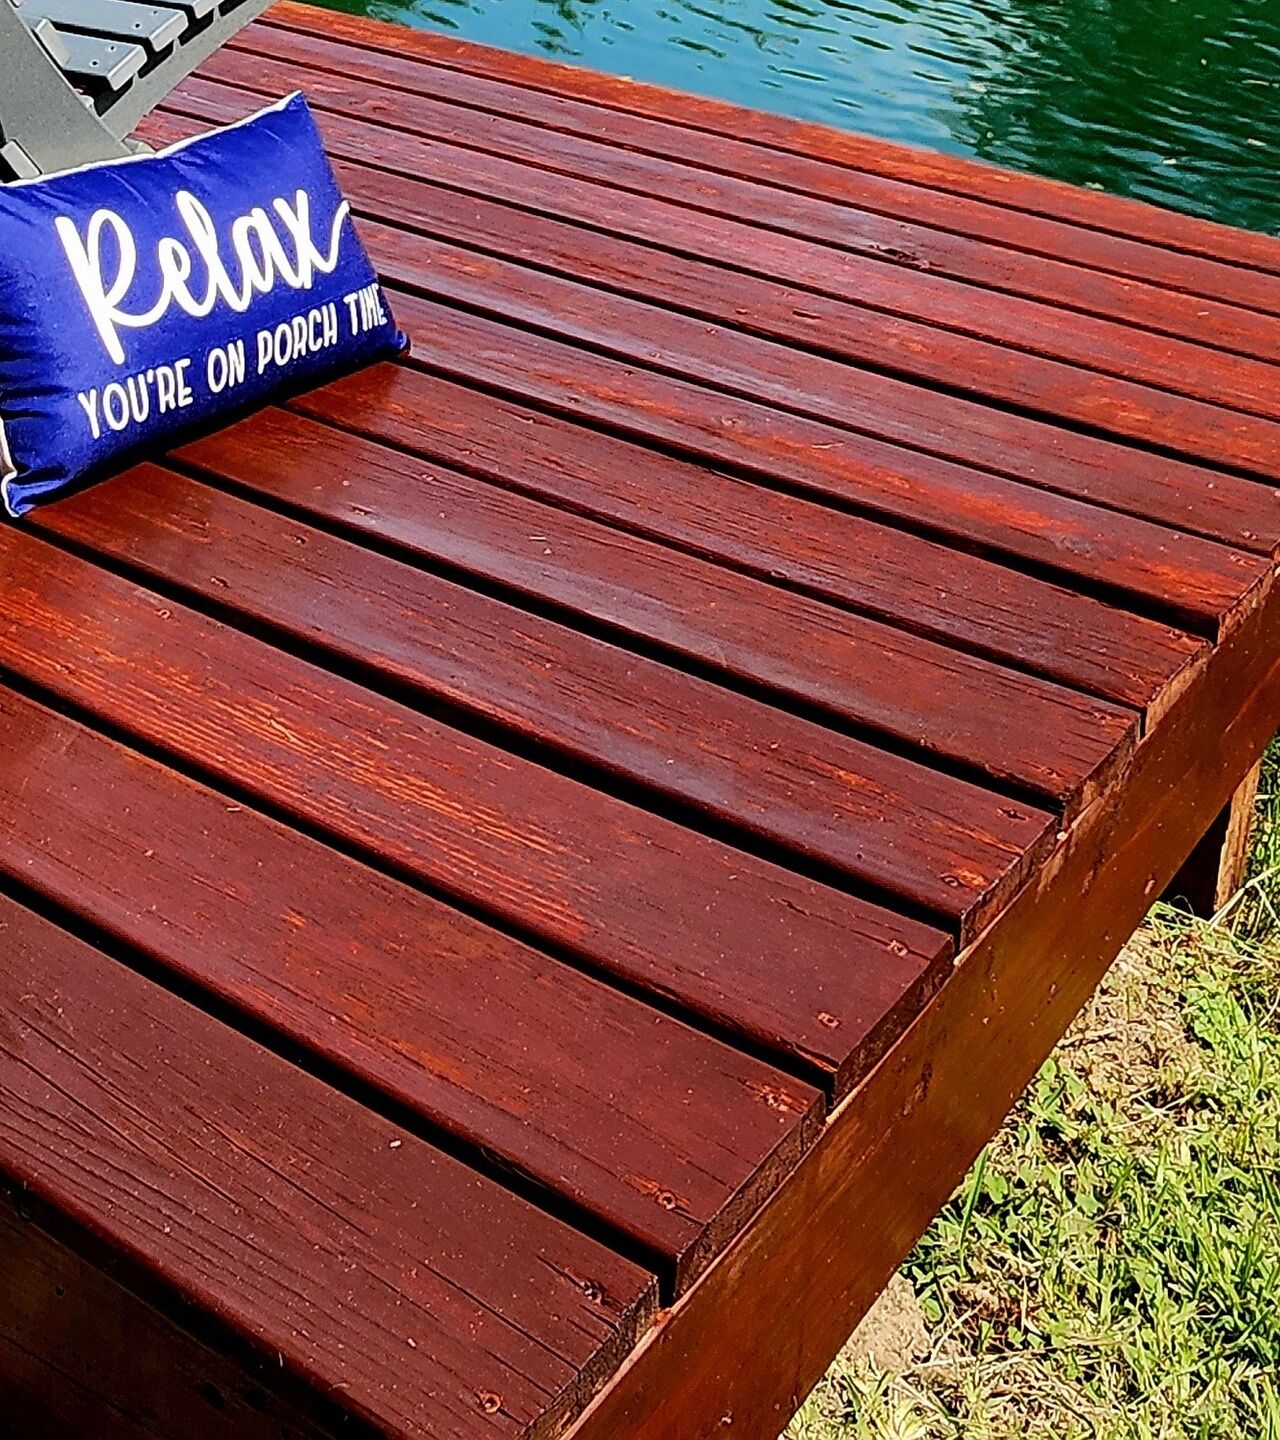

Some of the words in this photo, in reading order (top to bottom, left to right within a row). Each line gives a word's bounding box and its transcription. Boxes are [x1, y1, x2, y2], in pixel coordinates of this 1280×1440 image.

[55, 189, 350, 365] Relax
[77, 358, 194, 439] YOU'RE
[207, 339, 246, 393] ON
[257, 313, 338, 374] PORCH
[343, 282, 387, 336] TIME
